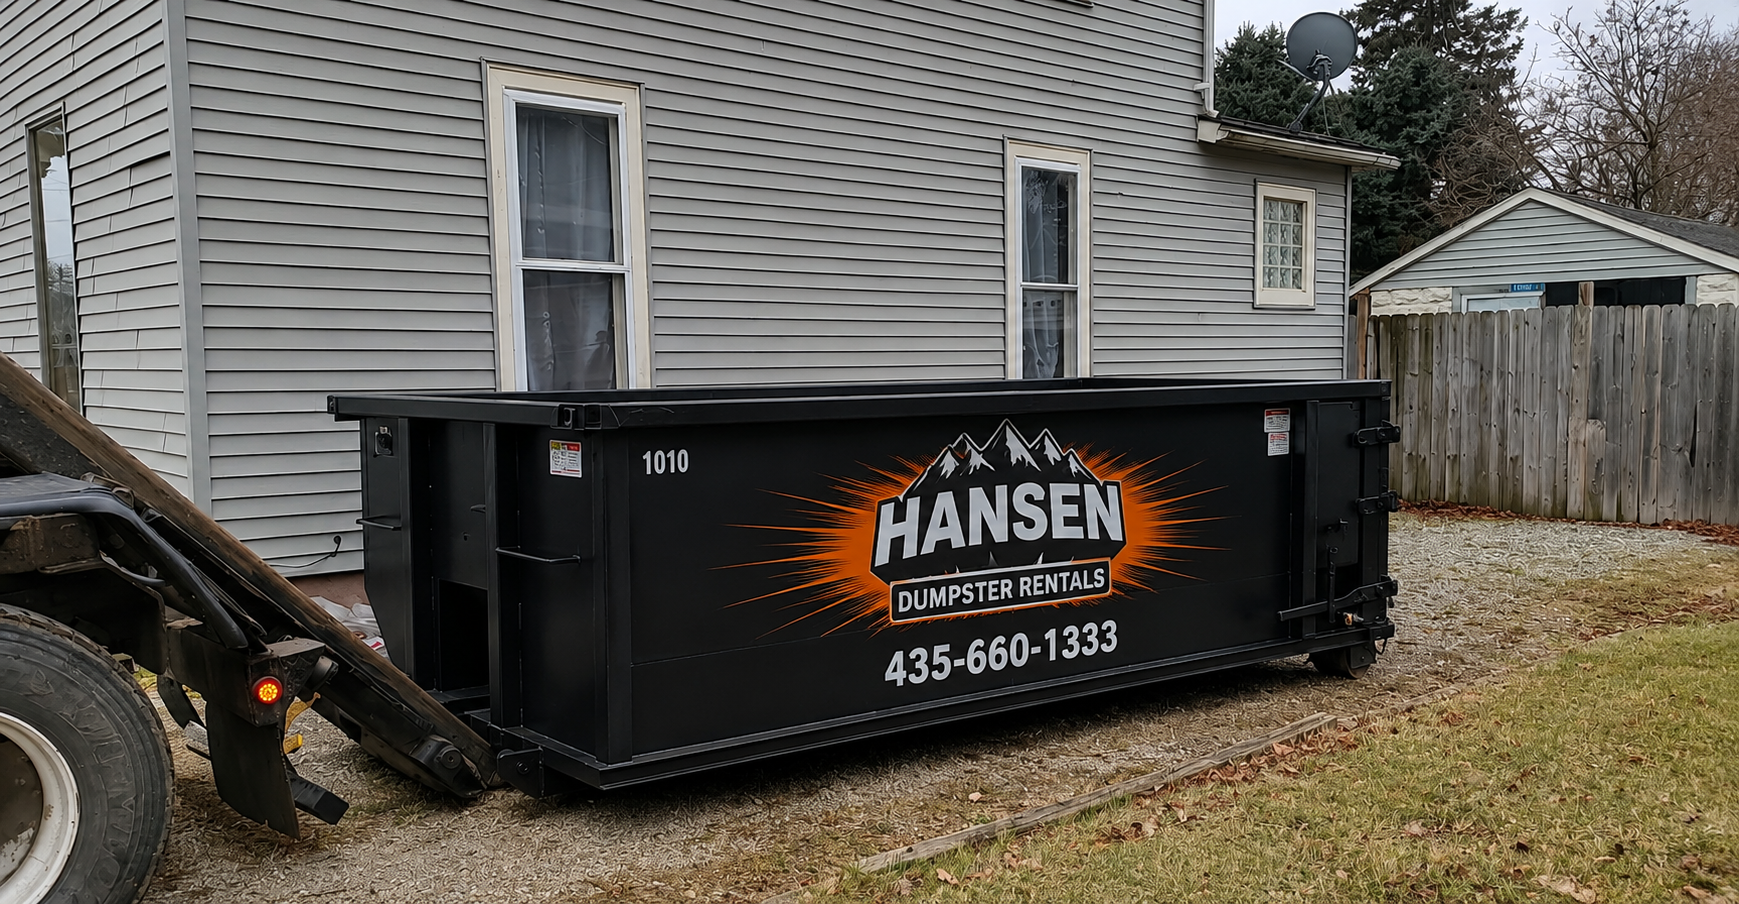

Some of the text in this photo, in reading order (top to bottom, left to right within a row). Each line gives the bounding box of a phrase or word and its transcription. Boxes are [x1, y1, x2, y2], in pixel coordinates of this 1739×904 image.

[642, 449, 689, 475] 1010
[874, 482, 1124, 567] HANSEN
[898, 568, 1105, 613] DUMPSTER RENTALS
[884, 619, 1118, 687] 435-660-1333
